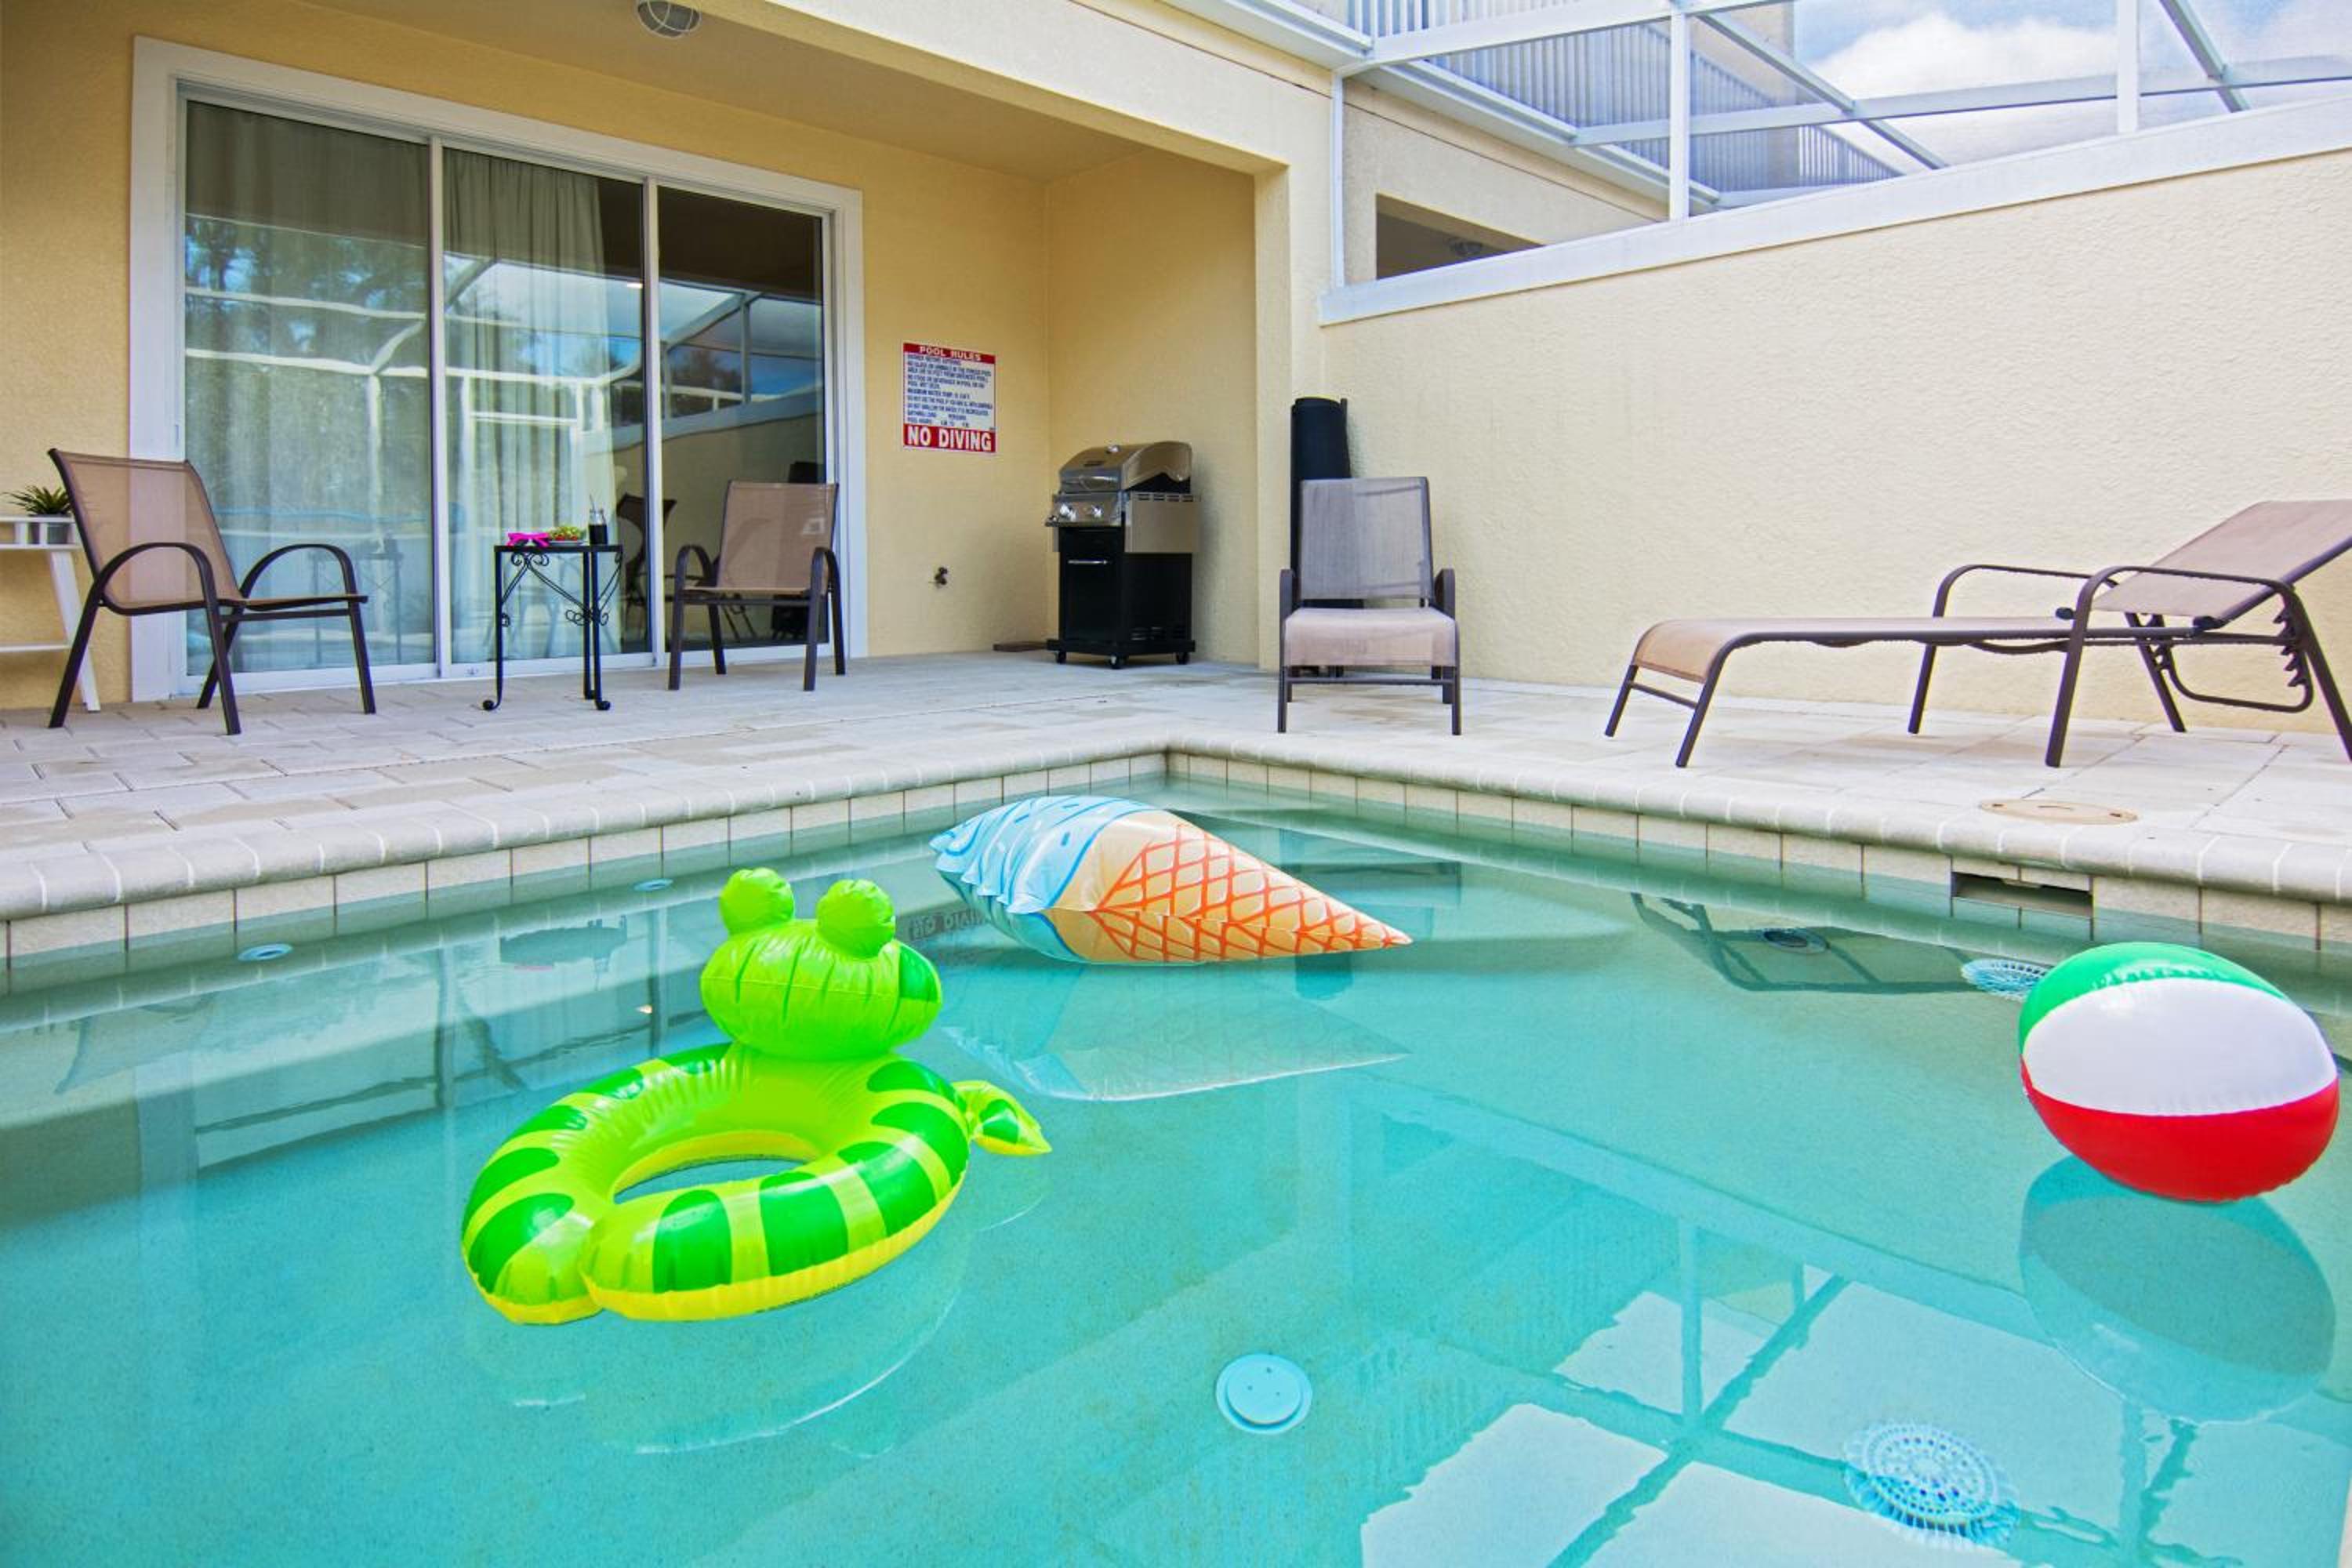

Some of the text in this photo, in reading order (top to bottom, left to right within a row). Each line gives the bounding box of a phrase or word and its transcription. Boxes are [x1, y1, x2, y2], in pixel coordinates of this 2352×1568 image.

[920, 347, 946, 357] POOL
[952, 350, 982, 361] RULES
[908, 426, 992, 451] NO DIVING
